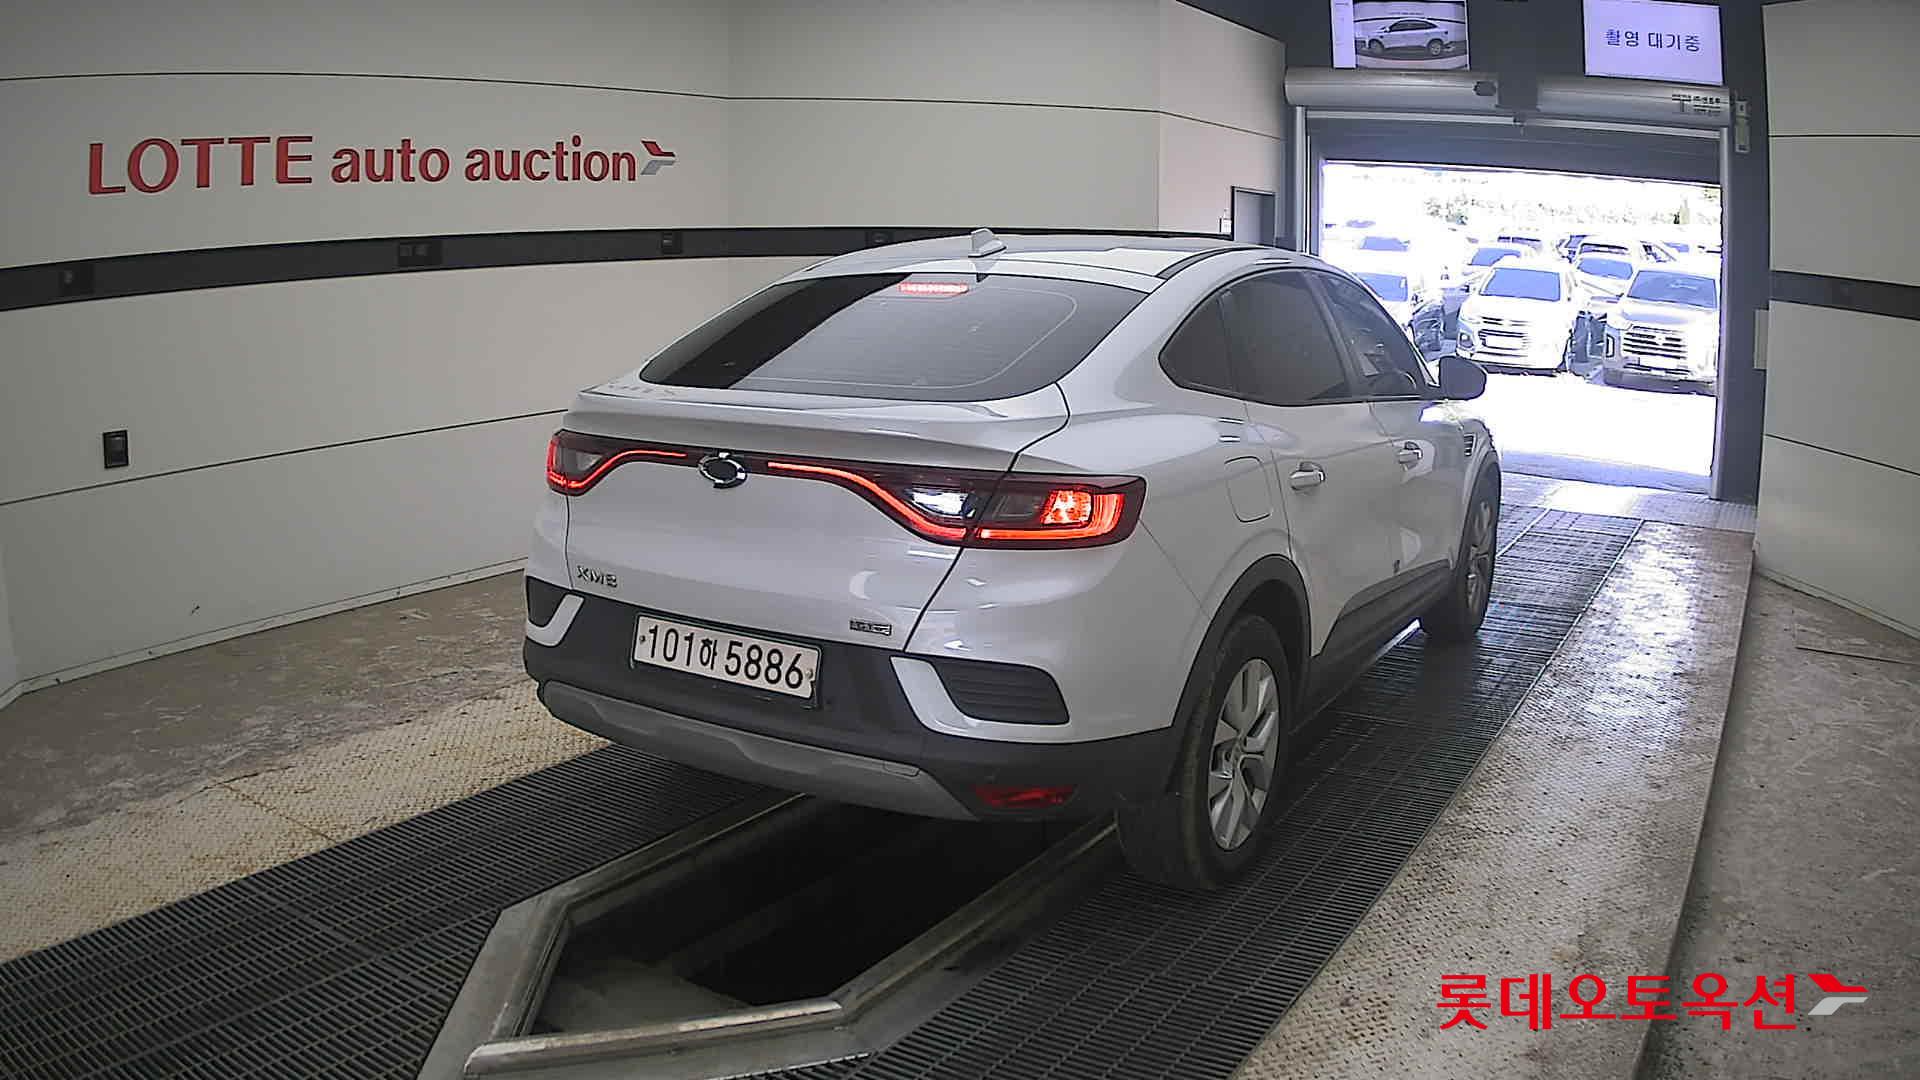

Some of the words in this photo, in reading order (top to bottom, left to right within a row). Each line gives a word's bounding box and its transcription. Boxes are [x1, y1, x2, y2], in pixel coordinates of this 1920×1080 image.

[1648, 32, 1700, 52] 대기중
[88, 136, 313, 195] LOTTE
[331, 138, 450, 183] auto
[464, 134, 637, 182] auction
